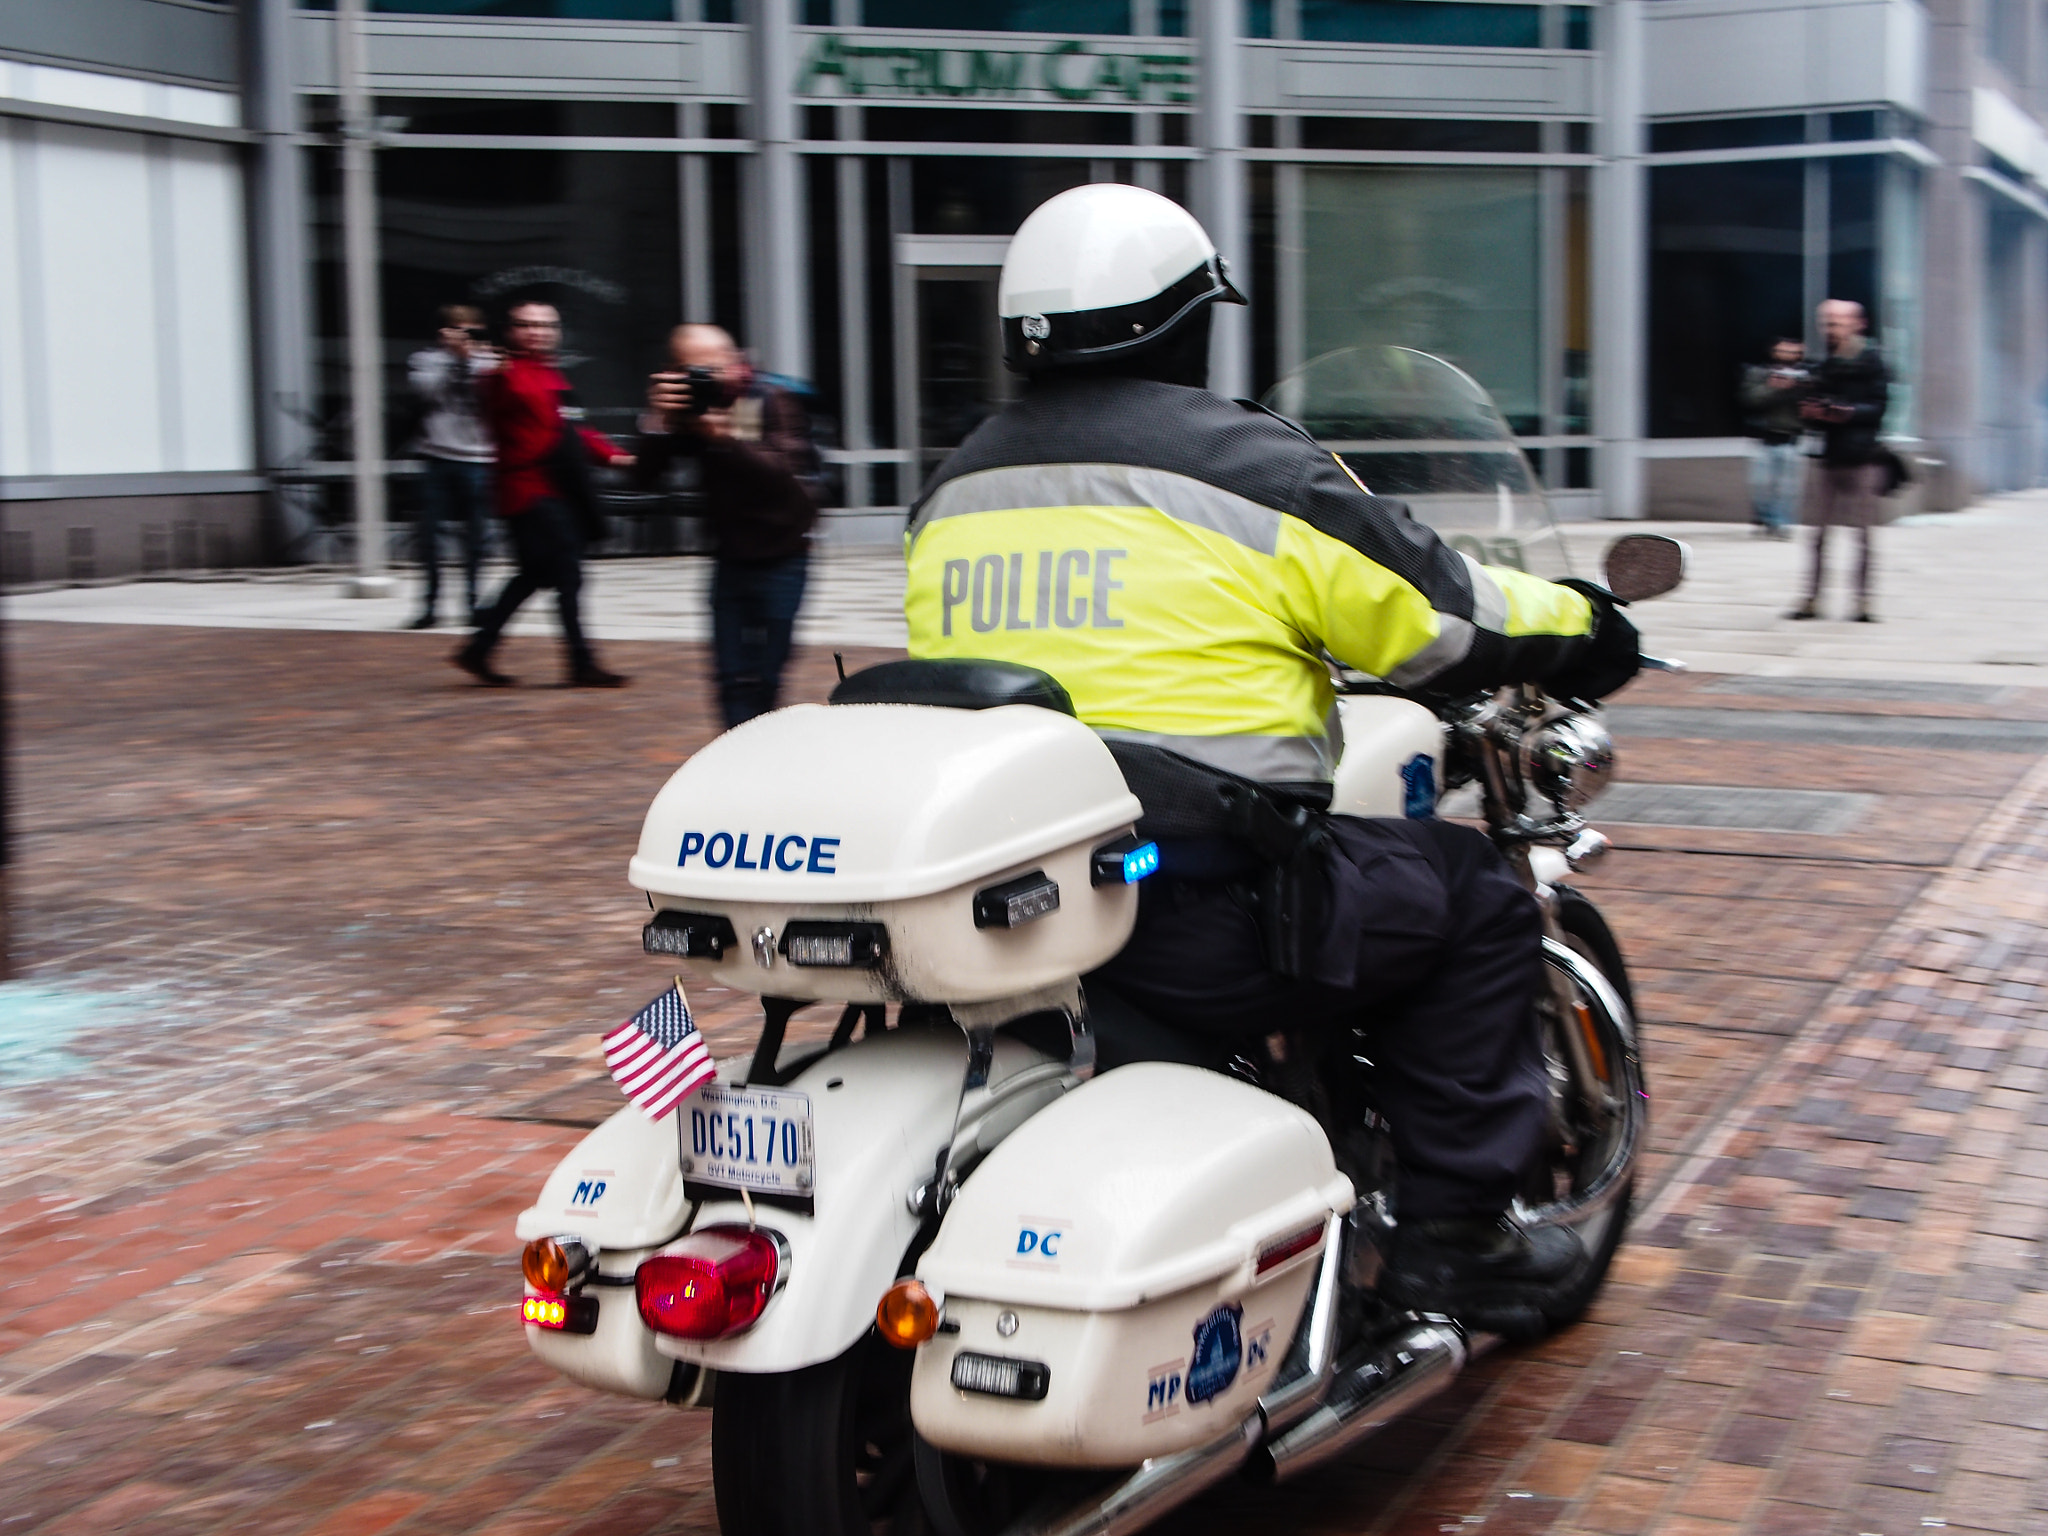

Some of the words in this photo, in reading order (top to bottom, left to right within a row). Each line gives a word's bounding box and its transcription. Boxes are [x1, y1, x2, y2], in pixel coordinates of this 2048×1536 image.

[795, 34, 1026, 97] ATRIUM
[1041, 40, 1194, 101] CAFE
[942, 549, 1127, 636] POLICE
[677, 832, 841, 874] POLICE
[692, 1107, 798, 1168] DC5170
[572, 1181, 607, 1204] MP
[1017, 1229, 1061, 1256] DC
[1147, 1371, 1181, 1411] MP
